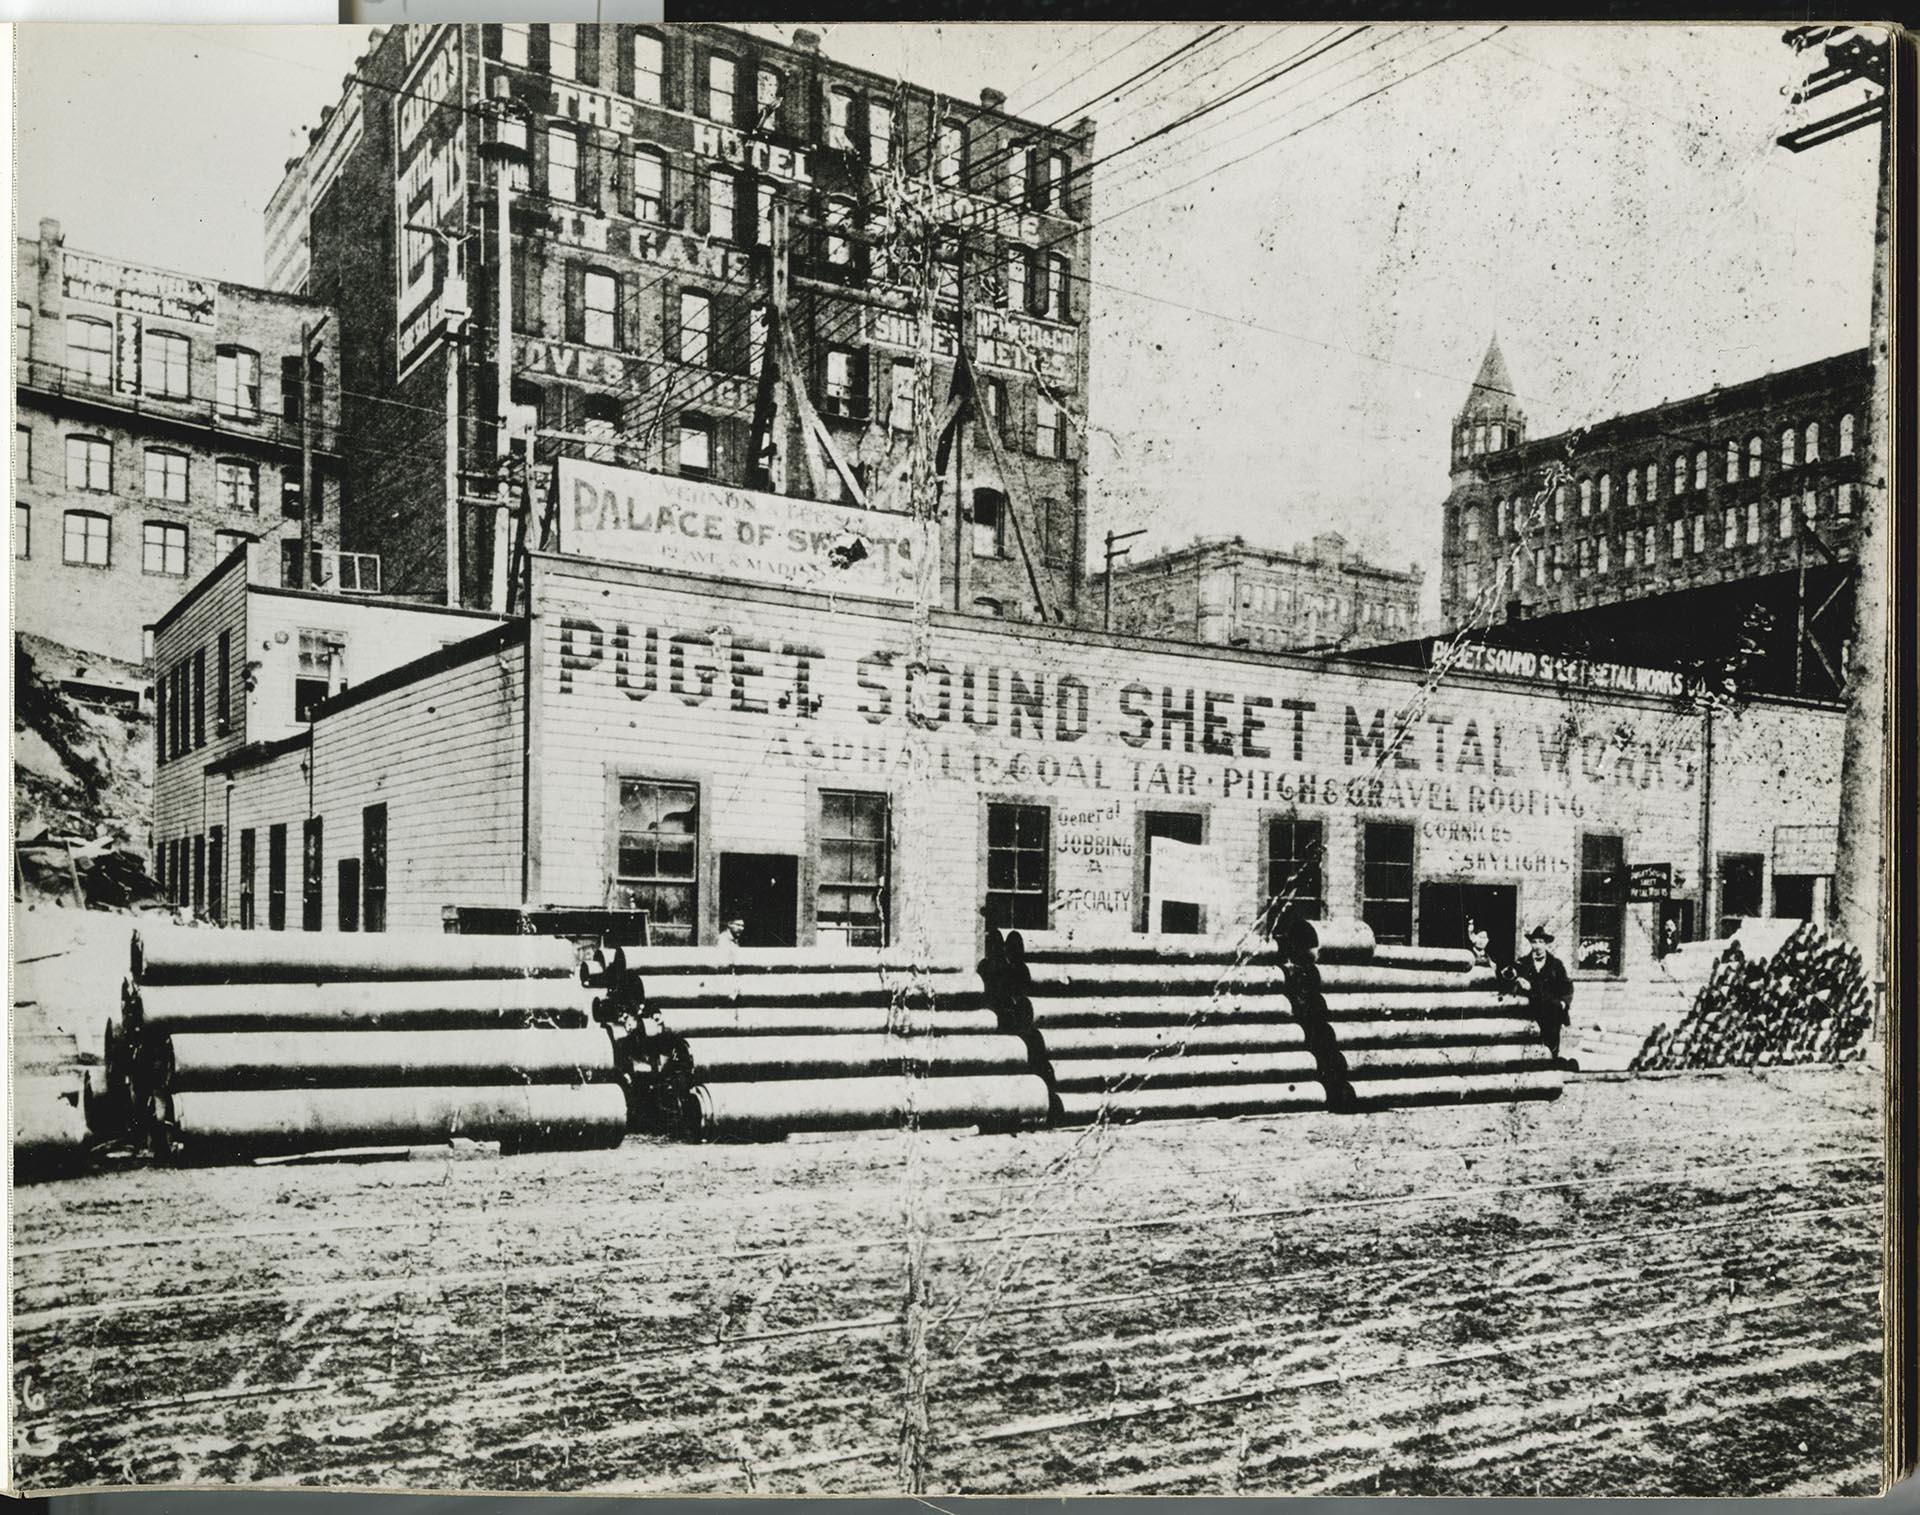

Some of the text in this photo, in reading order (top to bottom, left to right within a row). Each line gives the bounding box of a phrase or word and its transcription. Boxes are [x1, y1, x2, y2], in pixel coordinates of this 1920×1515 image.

[550, 81, 812, 182] THE HOTEL
[572, 476, 914, 581] PALACE OF SWTS
[1485, 647, 1537, 678] SOUND
[1636, 667, 1684, 697] WORKS
[559, 616, 827, 719] PUGET
[855, 649, 1090, 742] SOUND
[1118, 681, 1317, 761] SHEET
[1343, 704, 1521, 776] METAL
[1006, 751, 1113, 789] COAL
[1129, 758, 1198, 798] TAR
[1222, 766, 1317, 804] PITCH
[1345, 774, 1460, 811] GRAVEL
[1468, 784, 1586, 819] ROOFING
[1057, 799, 1121, 827] General
[1422, 819, 1513, 842] CORNICES
[1057, 833, 1133, 857] JOBBING
[1463, 851, 1570, 874] SKYLIGHTS
[1055, 887, 1131, 913] SPECIALTY
